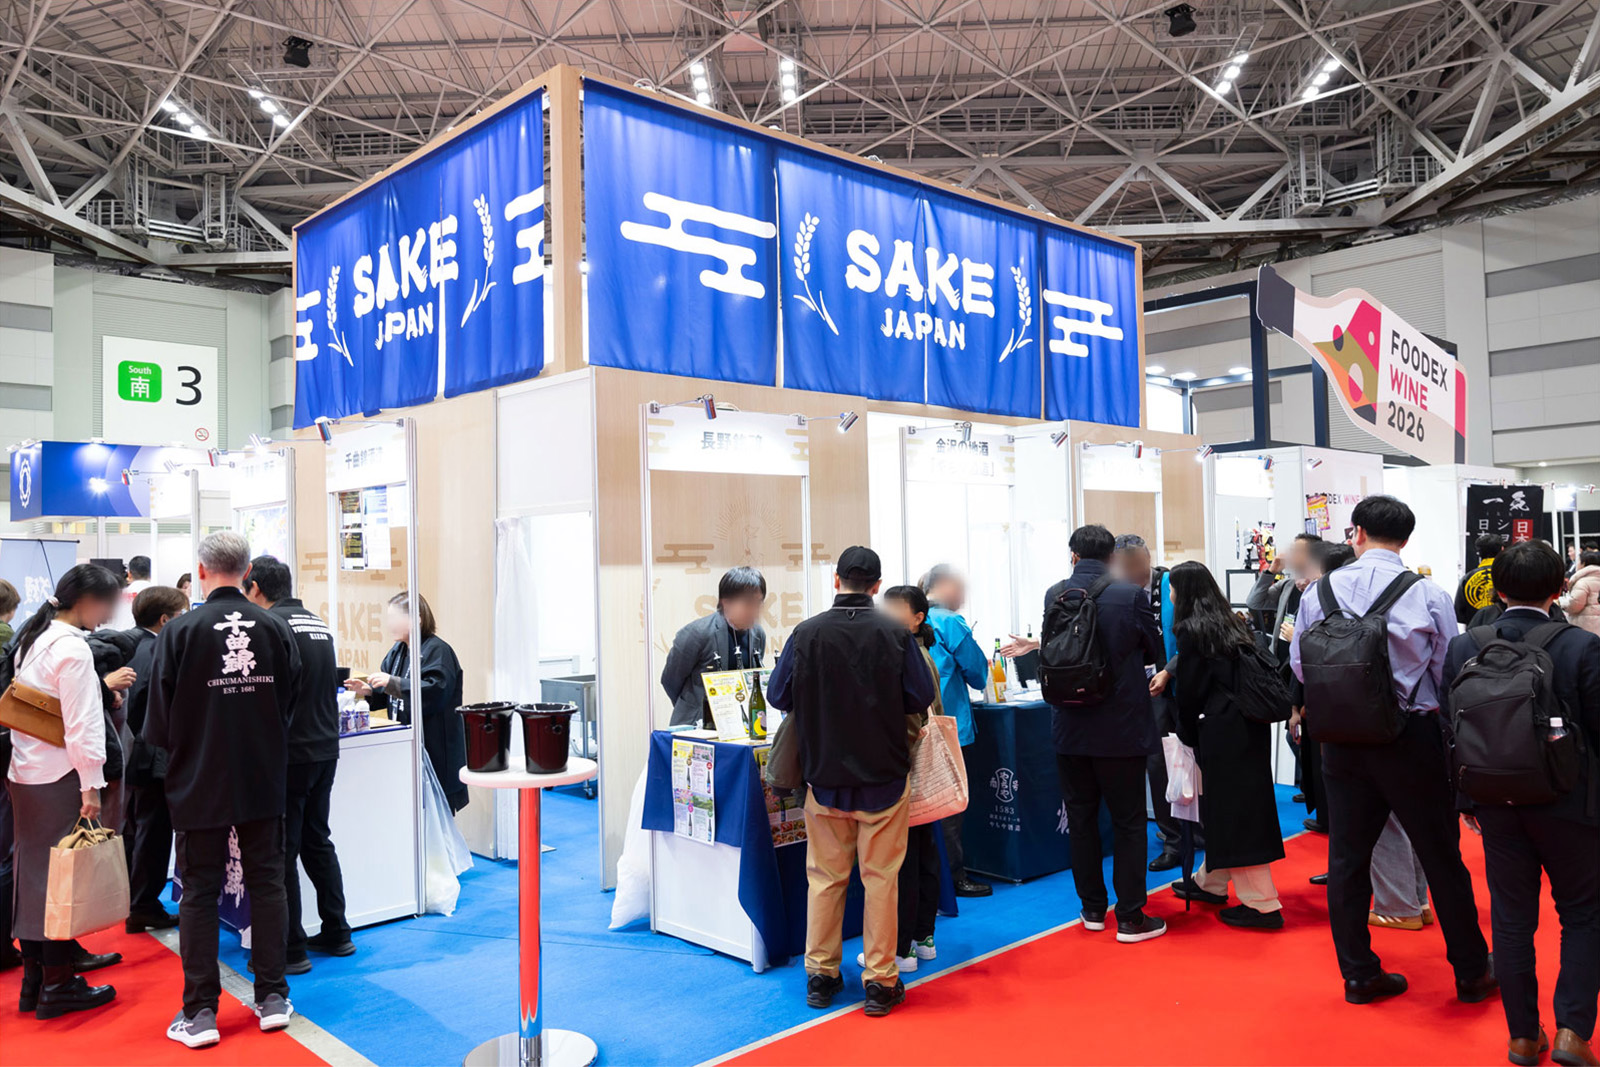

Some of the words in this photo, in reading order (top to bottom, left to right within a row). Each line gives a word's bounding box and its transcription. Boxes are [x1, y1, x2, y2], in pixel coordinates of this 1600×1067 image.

[353, 214, 459, 318] SAKE
[845, 229, 995, 319] SAKE
[375, 302, 434, 350] JPAN
[880, 307, 966, 350] JAPAN
[128, 365, 152, 375] South
[1391, 329, 1448, 392] FOODEX
[130, 376, 151, 399] 南
[175, 365, 202, 406] 3
[1390, 363, 1428, 411] WINE
[701, 431, 763, 450] 長野
[1387, 400, 1425, 442] 2026
[936, 438, 989, 456] 金沢の地酒
[213, 611, 257, 677] 千曲錦
[207, 675, 274, 687] CHIKUMANISHIKI
[995, 805, 1015, 815] 1583
